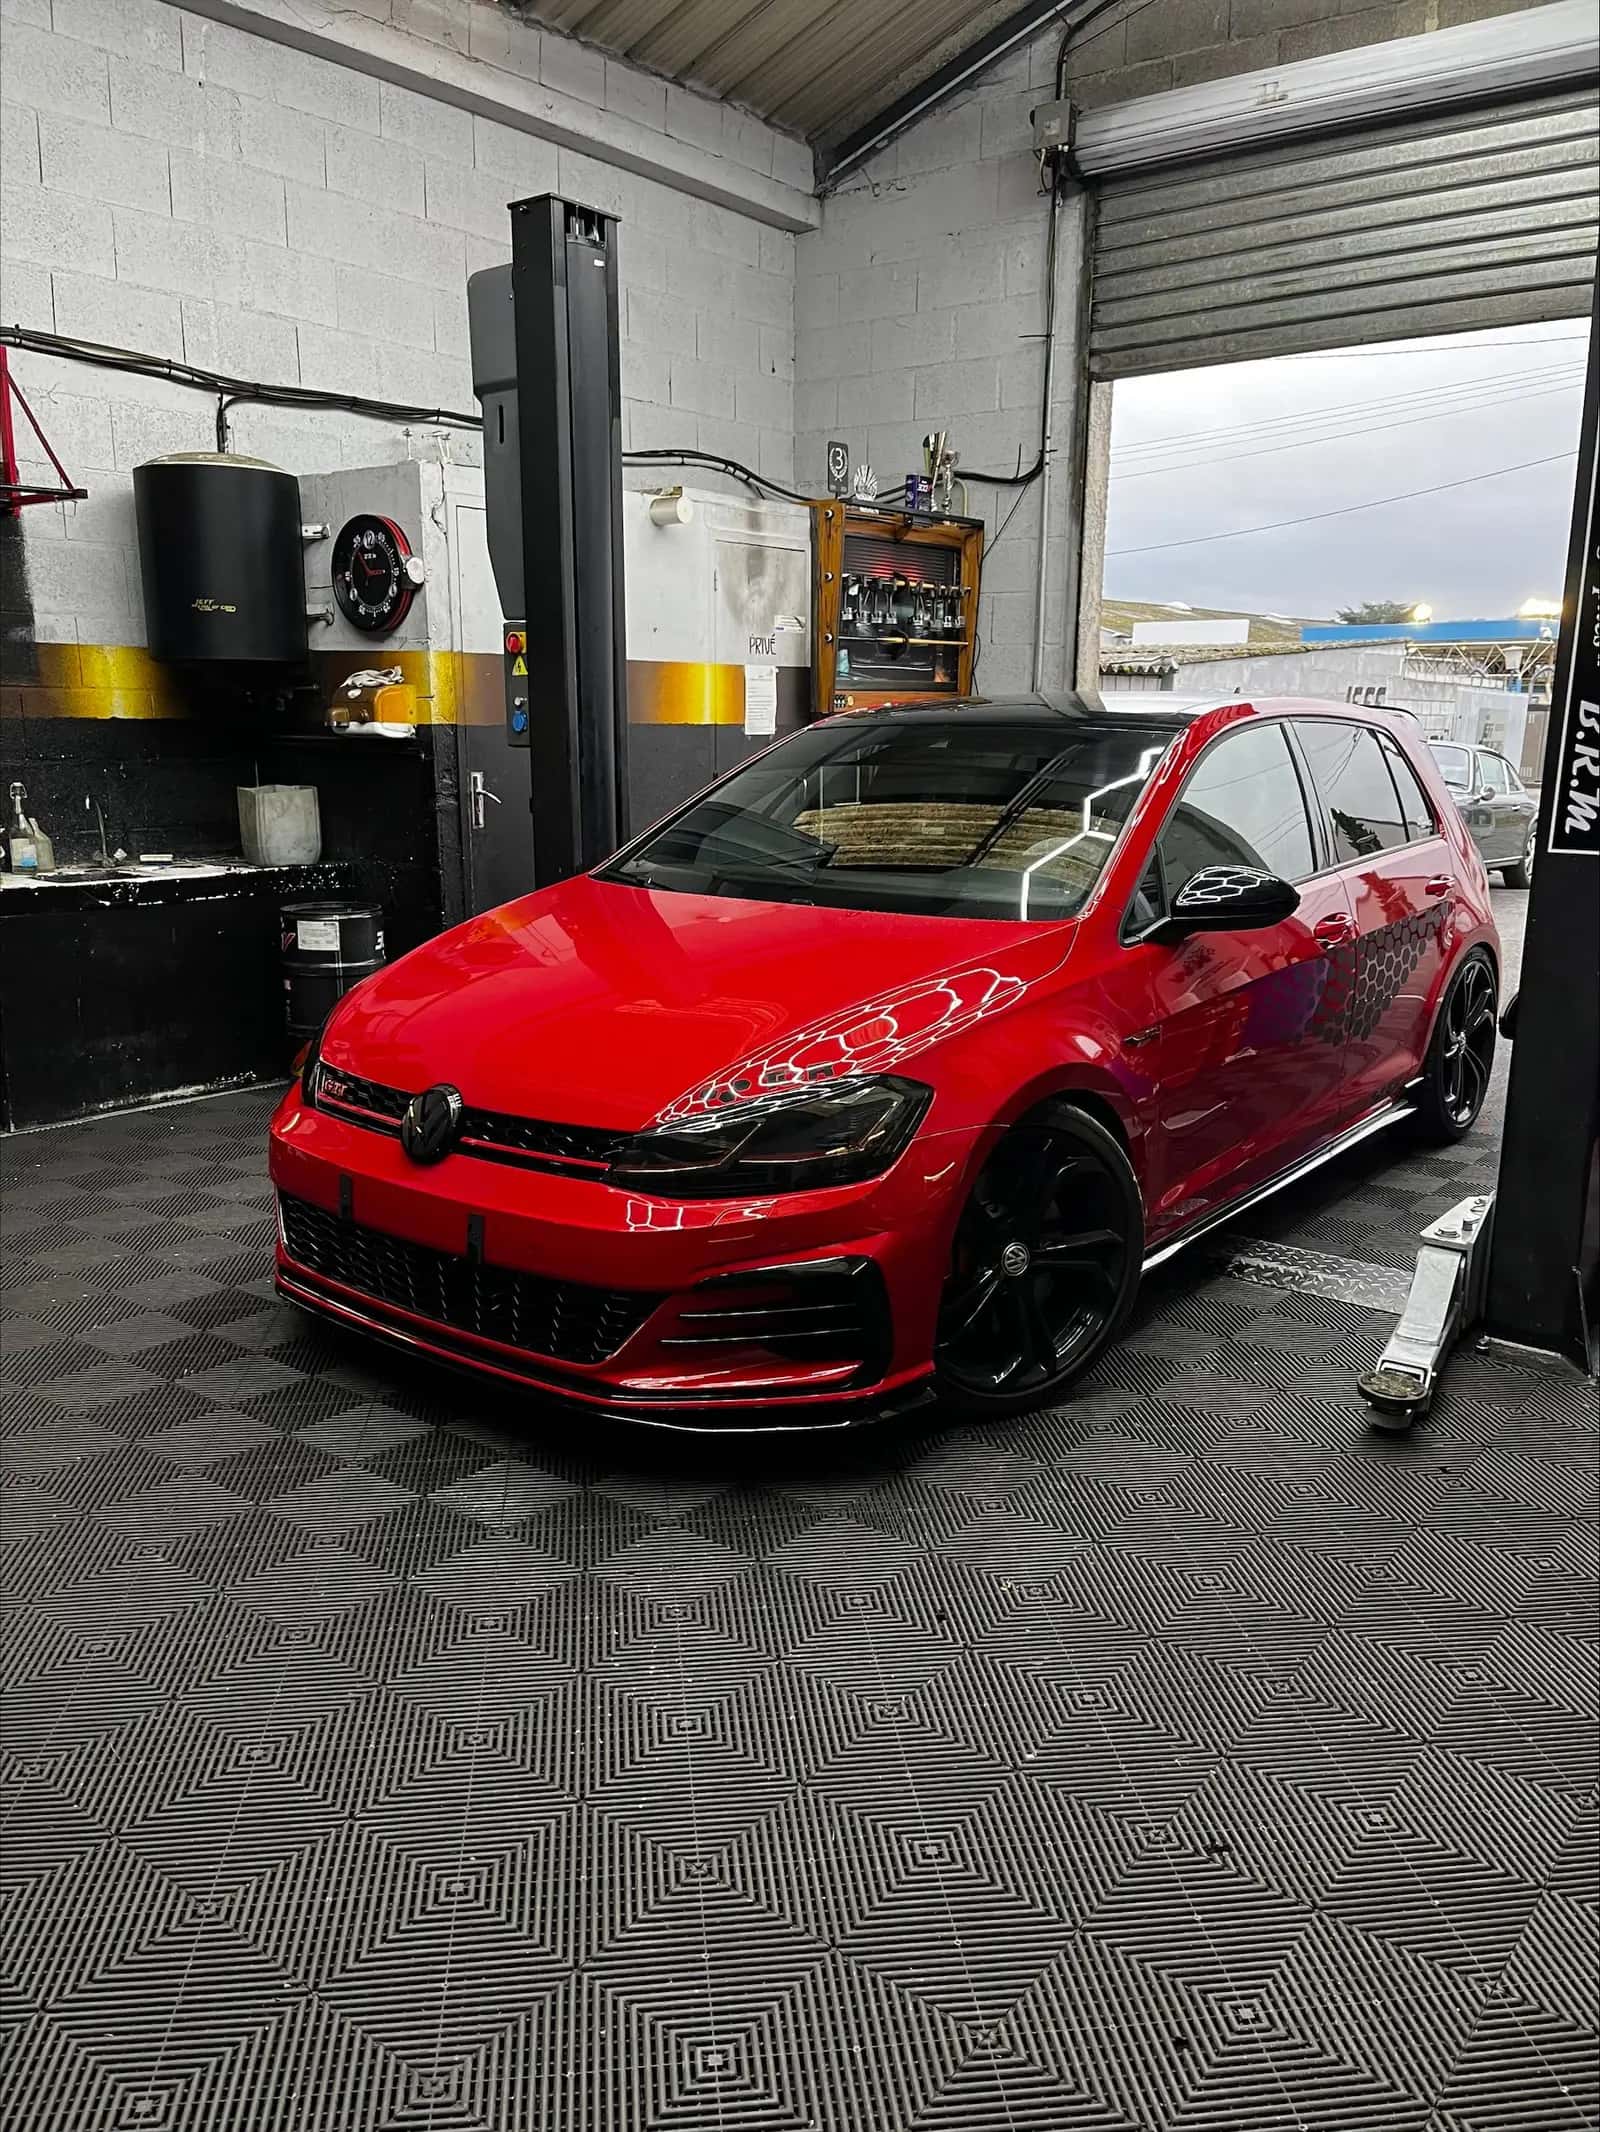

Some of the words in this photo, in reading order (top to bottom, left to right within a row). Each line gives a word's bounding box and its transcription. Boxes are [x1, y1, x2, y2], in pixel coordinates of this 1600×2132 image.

[836, 448, 844, 470] 3
[749, 633, 776, 656] PRIVÉ
[325, 1079, 348, 1096] GTI
